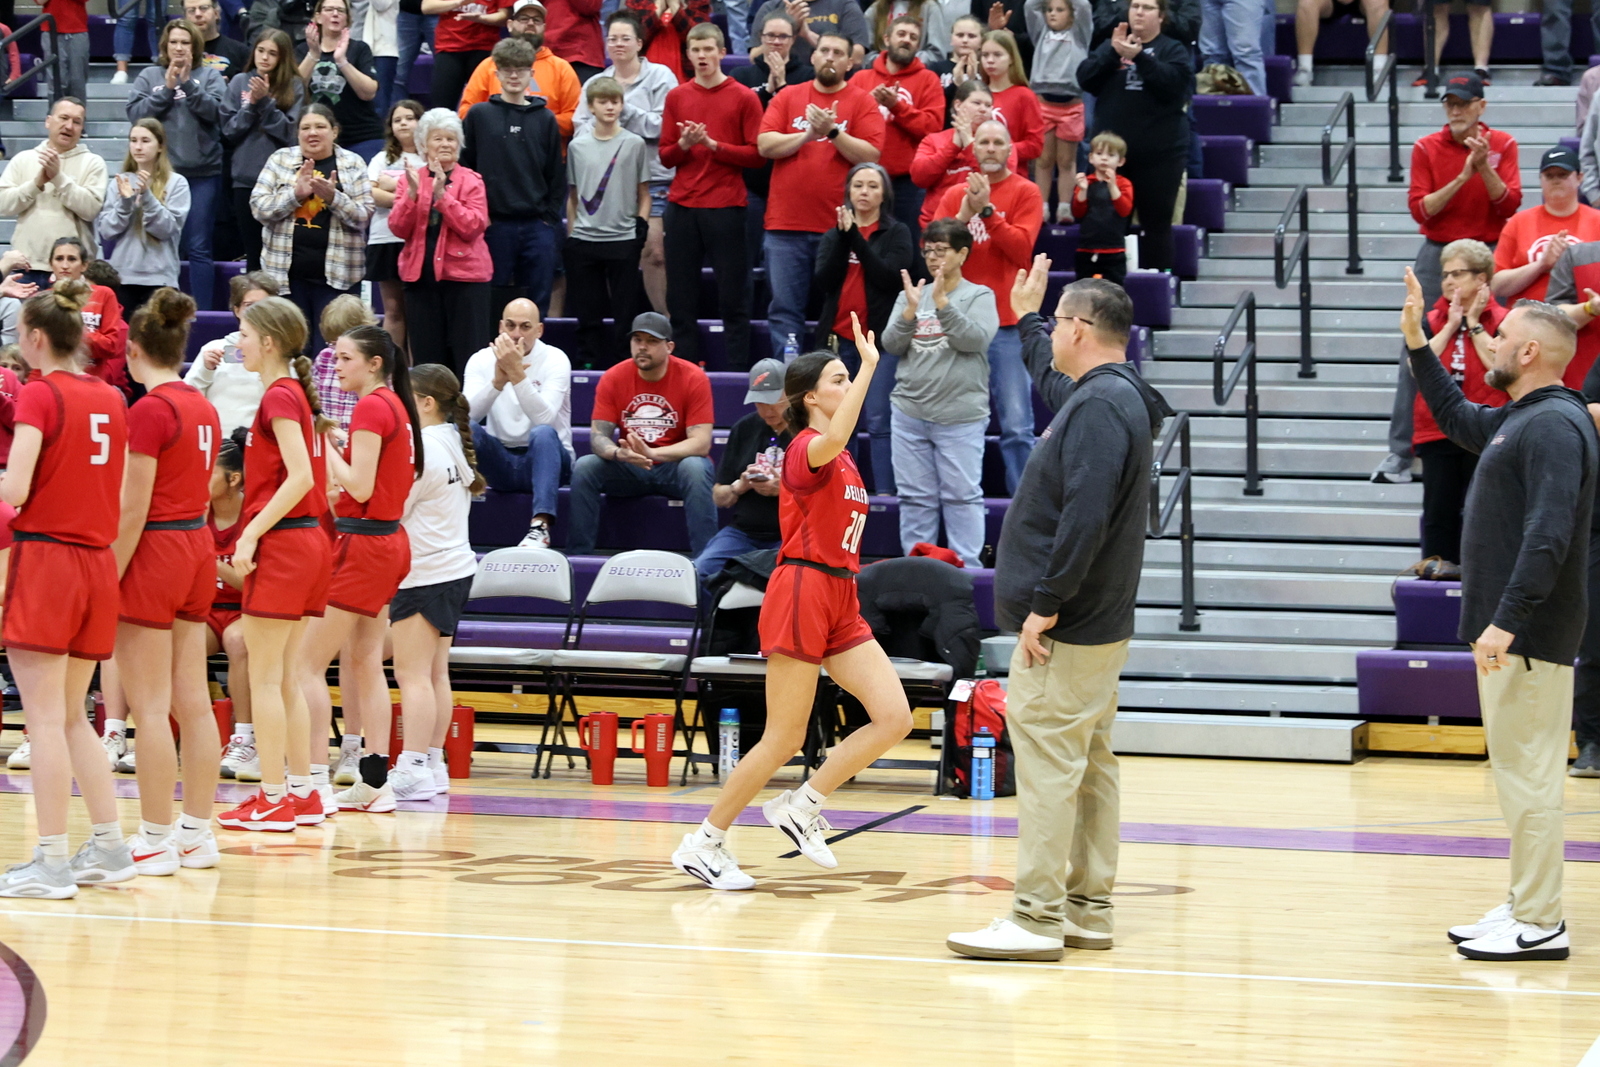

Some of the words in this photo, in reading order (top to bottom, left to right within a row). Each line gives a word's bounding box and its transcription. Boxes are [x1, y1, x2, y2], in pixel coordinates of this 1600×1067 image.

[89, 413, 111, 466] 5
[197, 424, 213, 471] 4
[841, 509, 868, 555] 20
[484, 561, 561, 574] BLUFFTON
[608, 565, 687, 579] BLUFFTON
[656, 722, 667, 752] FREITAG
